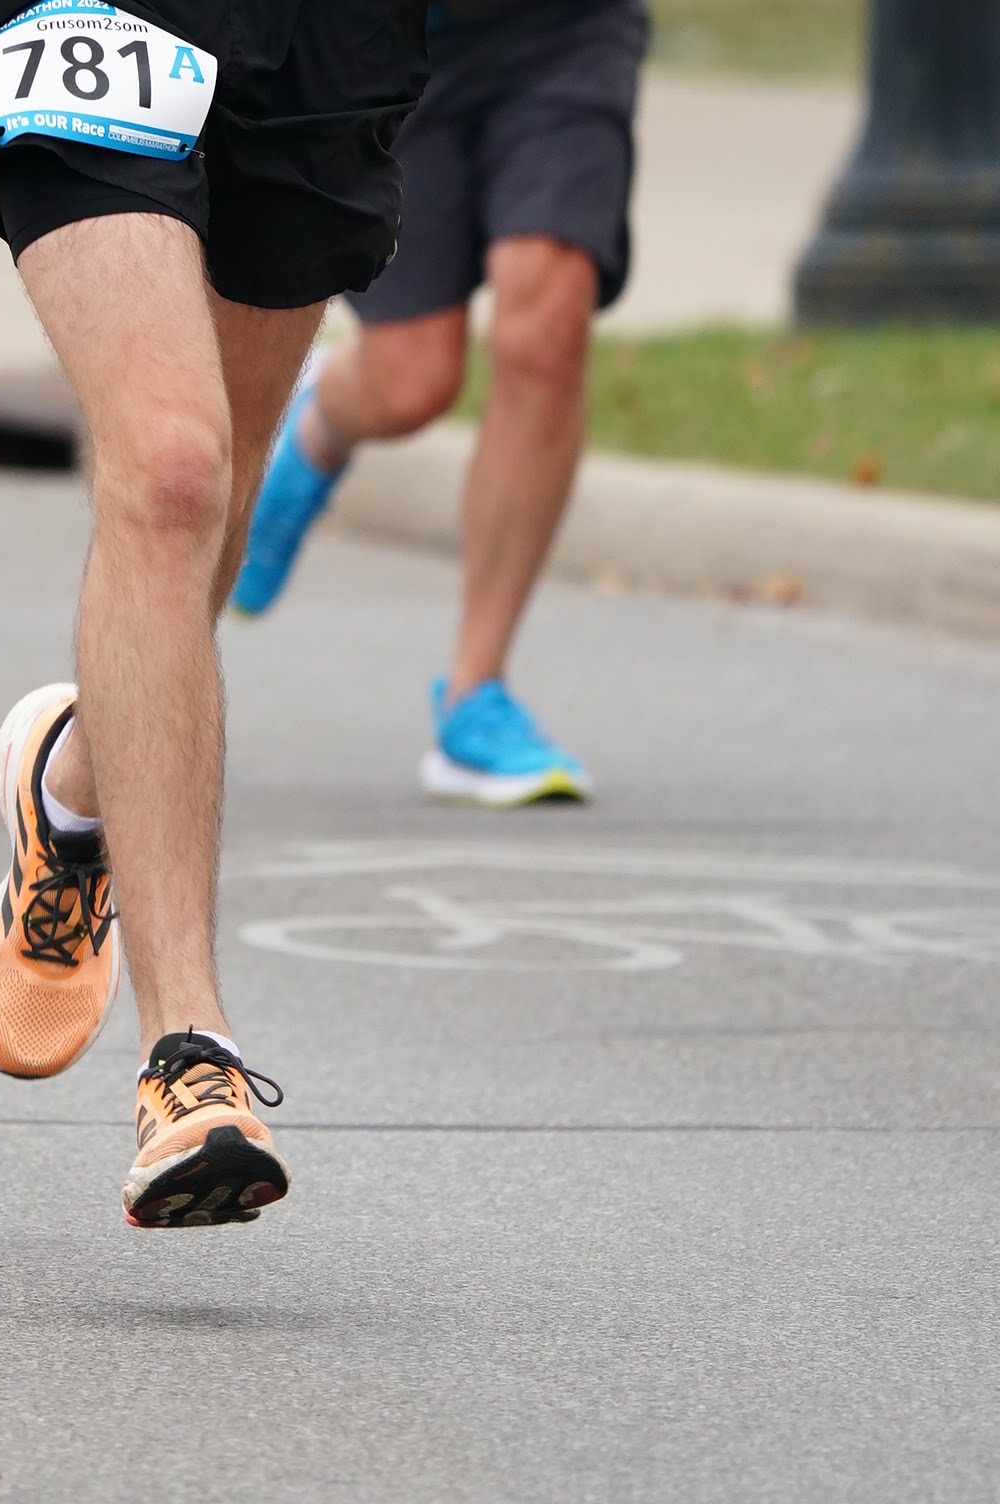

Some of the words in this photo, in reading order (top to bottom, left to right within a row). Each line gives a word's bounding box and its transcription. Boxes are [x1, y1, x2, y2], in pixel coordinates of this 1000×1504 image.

[36, 17, 149, 34] Grusom2som
[2, 35, 152, 110] 781
[168, 45, 205, 84] A
[6, 115, 30, 132] It's
[33, 113, 68, 130] OUR
[71, 117, 106, 139] Race
